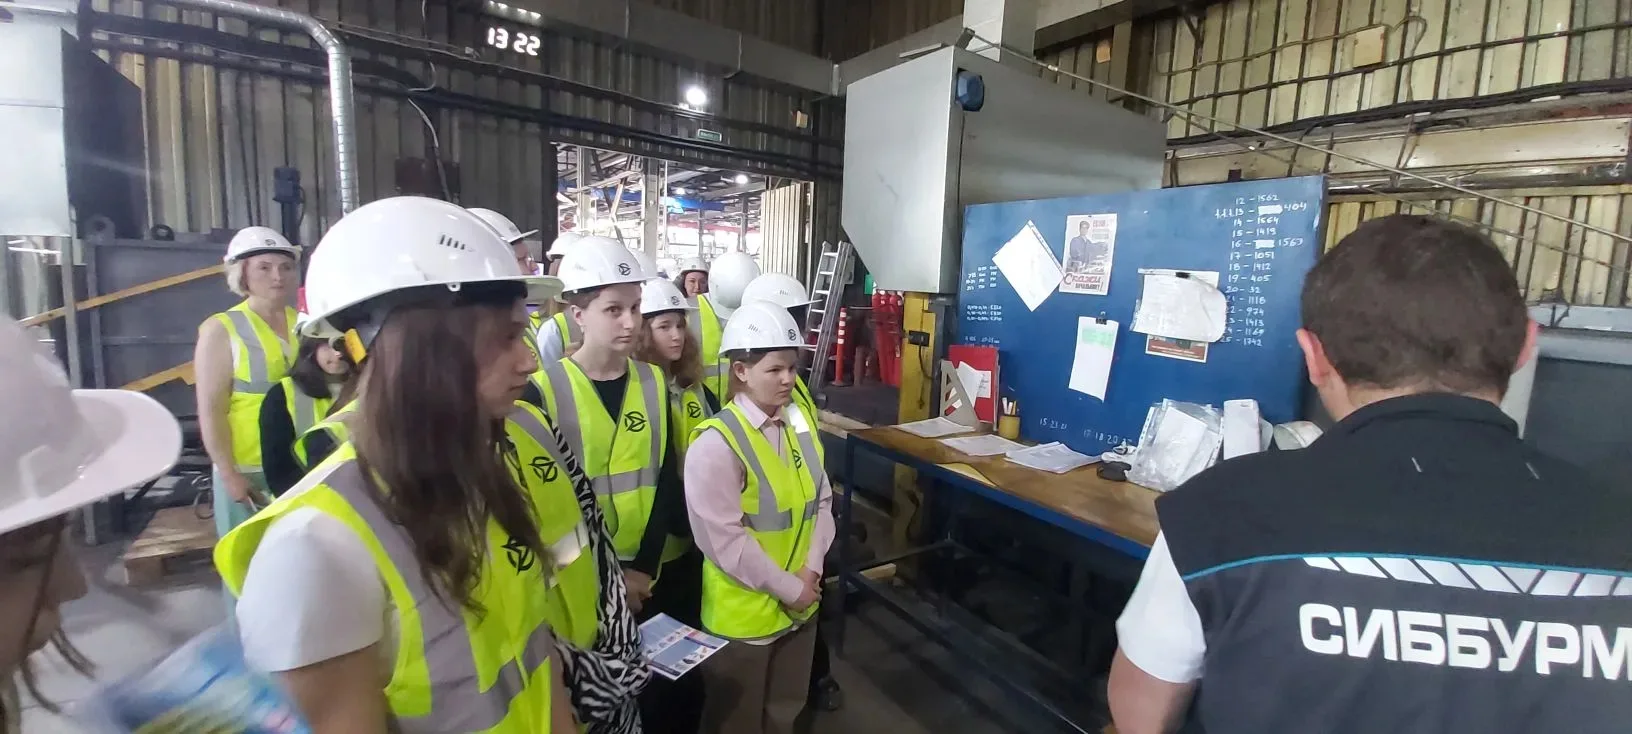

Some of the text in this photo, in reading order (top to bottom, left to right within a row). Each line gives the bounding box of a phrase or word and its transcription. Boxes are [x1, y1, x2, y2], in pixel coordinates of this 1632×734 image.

[488, 27, 540, 56] 13 22
[1284, 201, 1307, 211] 404
[1231, 240, 1242, 248] 16
[1230, 252, 1240, 260] 17
[1253, 263, 1271, 271] 1412
[1228, 274, 1238, 282] 19
[1107, 434, 1118, 444] 20
[1299, 602, 1632, 681] СИББУРМ
